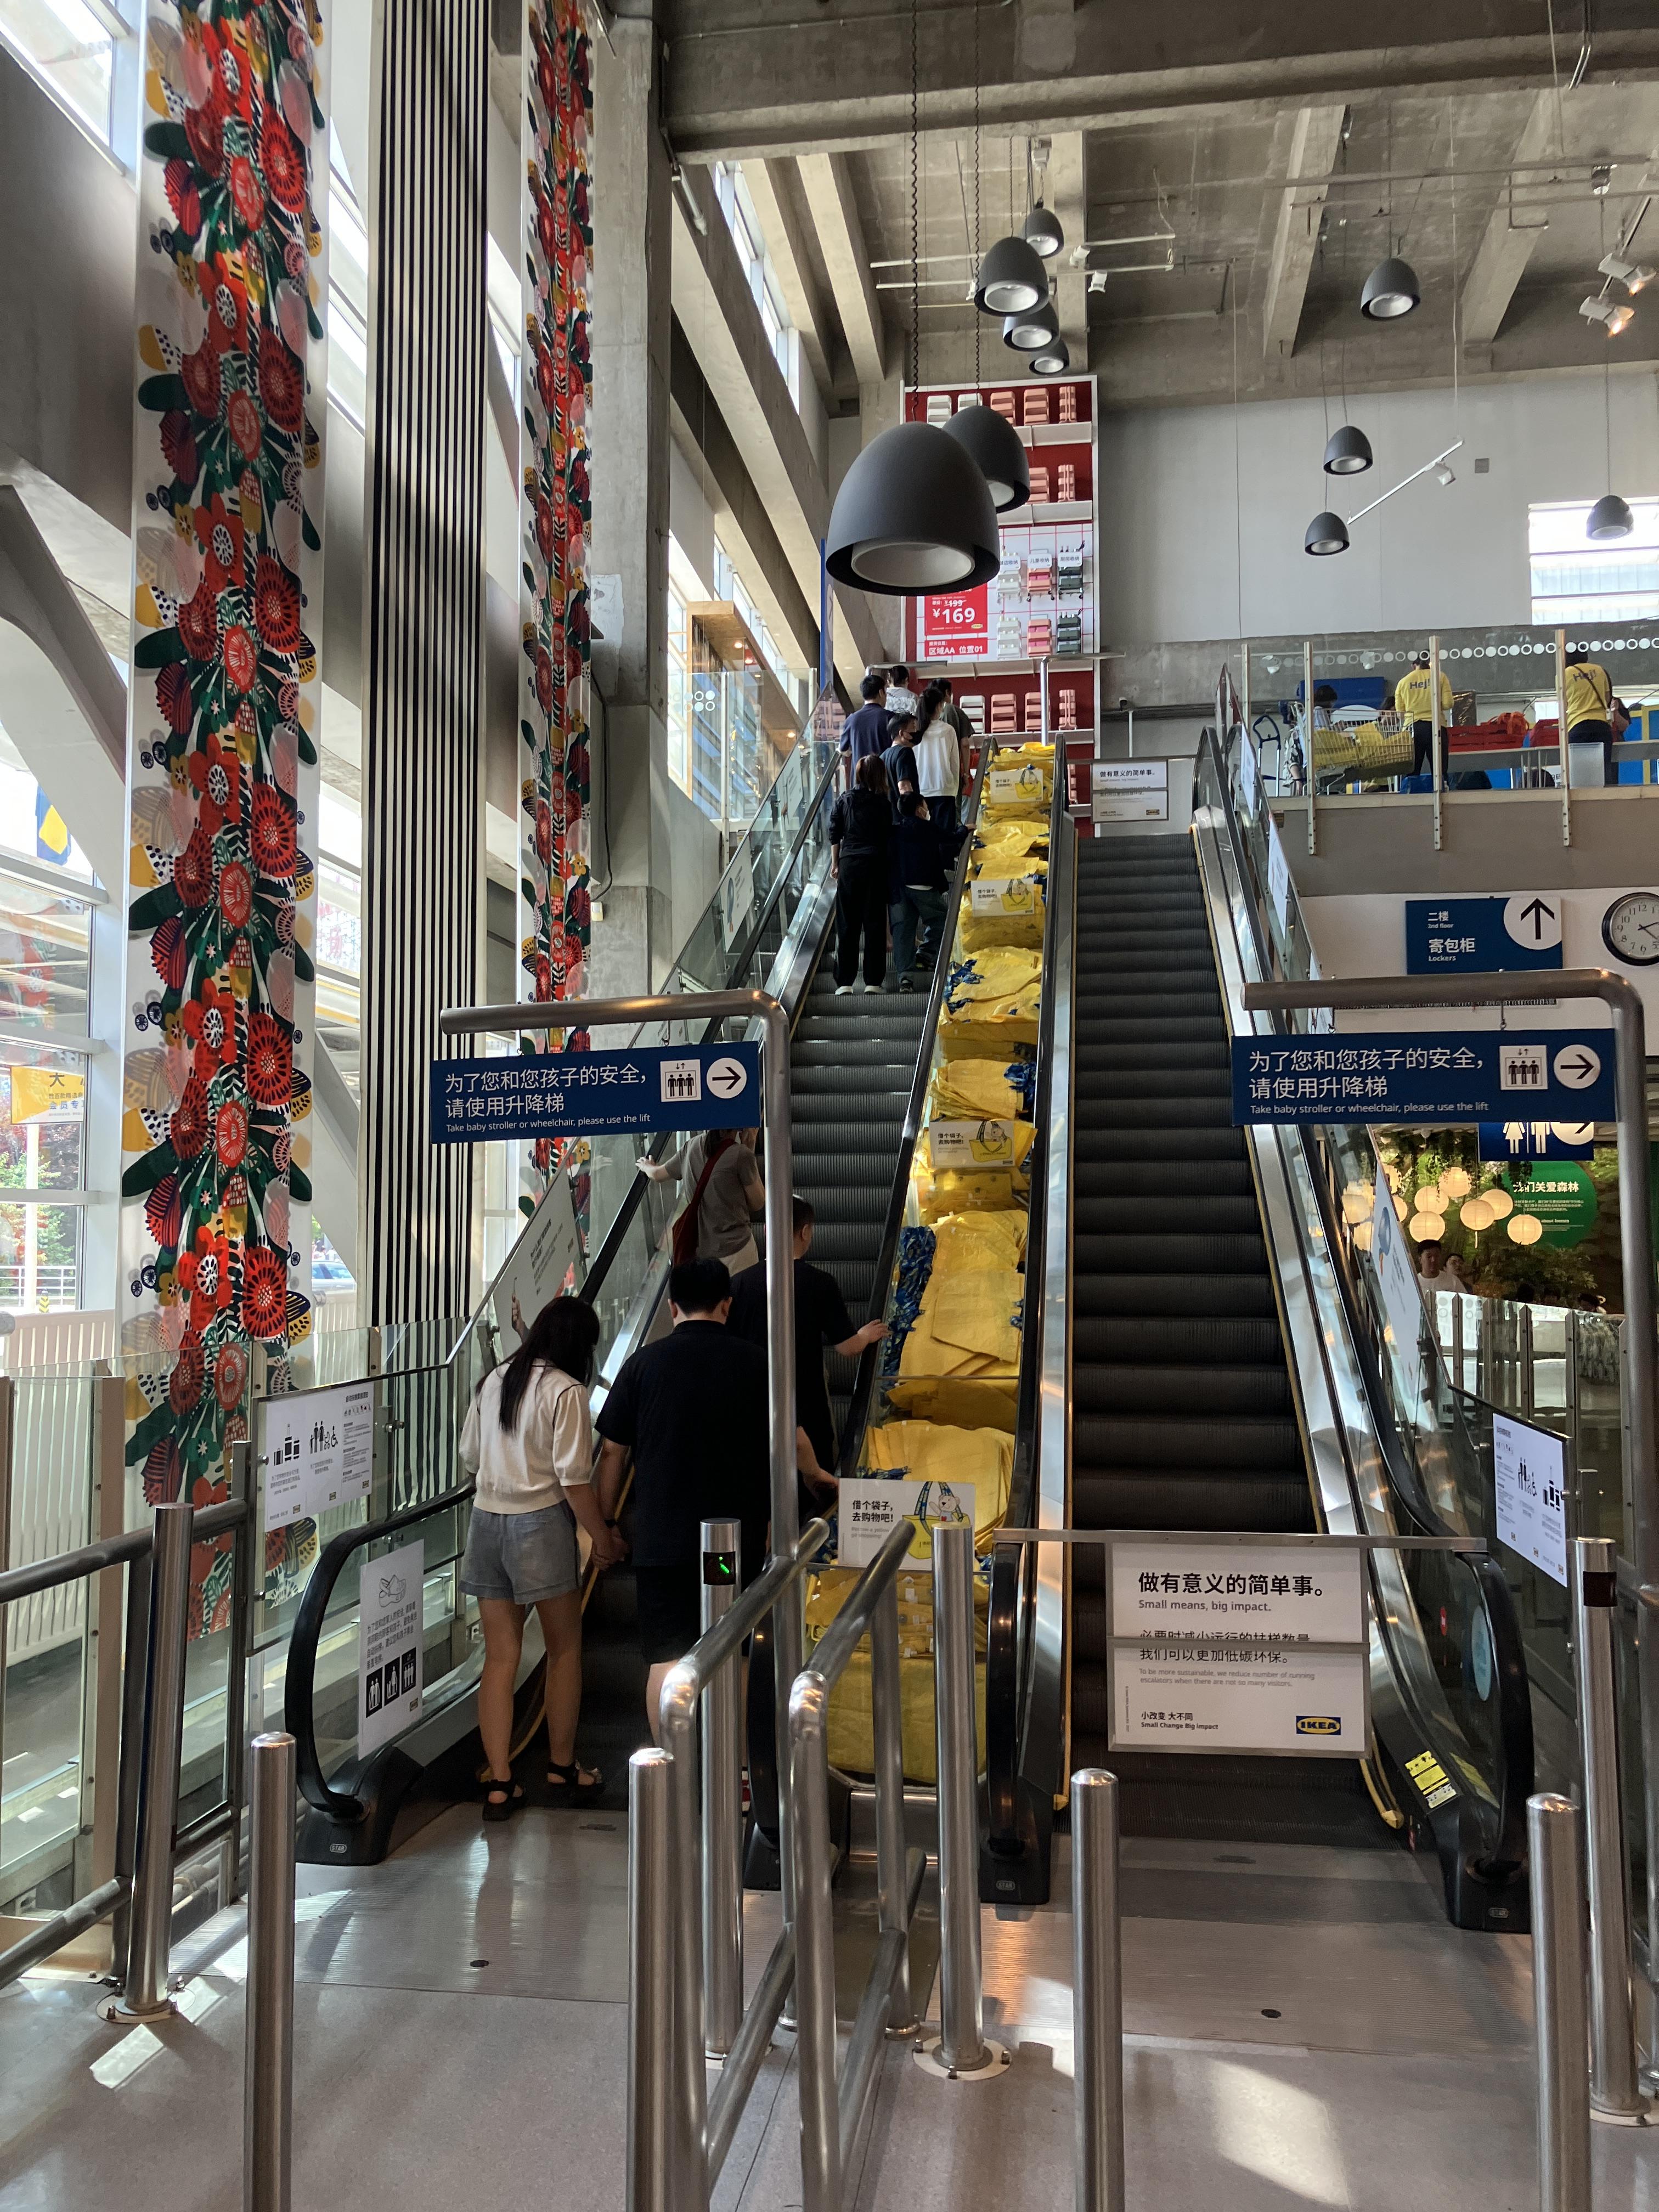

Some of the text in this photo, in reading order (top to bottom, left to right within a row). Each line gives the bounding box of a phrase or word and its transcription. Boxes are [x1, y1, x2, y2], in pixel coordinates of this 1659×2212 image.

[933, 607, 975, 624] ¥169
[1410, 678, 1430, 689] Hej!
[1428, 911, 1449, 922] 二楼
[1429, 938, 1476, 953] 寄包柜
[1249, 1076, 1388, 1099] 请使用升降梯
[49, 1100, 84, 1109] 会员专
[445, 1092, 565, 1119] 请使用升降梯
[1250, 1105, 1271, 1114] Take
[1274, 1104, 1297, 1116] baby
[1299, 1104, 1333, 1113] stroller
[1348, 1103, 1401, 1113] wheelchair,
[1403, 1103, 1435, 1114] please
[1457, 1102, 1473, 1111] the
[1475, 1102, 1489, 1110] lift
[446, 1124, 464, 1132] Take
[466, 1122, 487, 1133] baby
[488, 1121, 517, 1130] stroller
[530, 1118, 575, 1128] wheelchair,
[578, 1116, 605, 1127] please
[623, 1115, 637, 1123] the
[639, 1114, 651, 1122] lift
[1138, 1572, 1324, 1597] 做有意义的简单事。
[1138, 1600, 1271, 1613] Small means, big impact.
[1141, 1711, 1193, 1721] 小改变 大不同
[1301, 1721, 1338, 1730] IKEA
